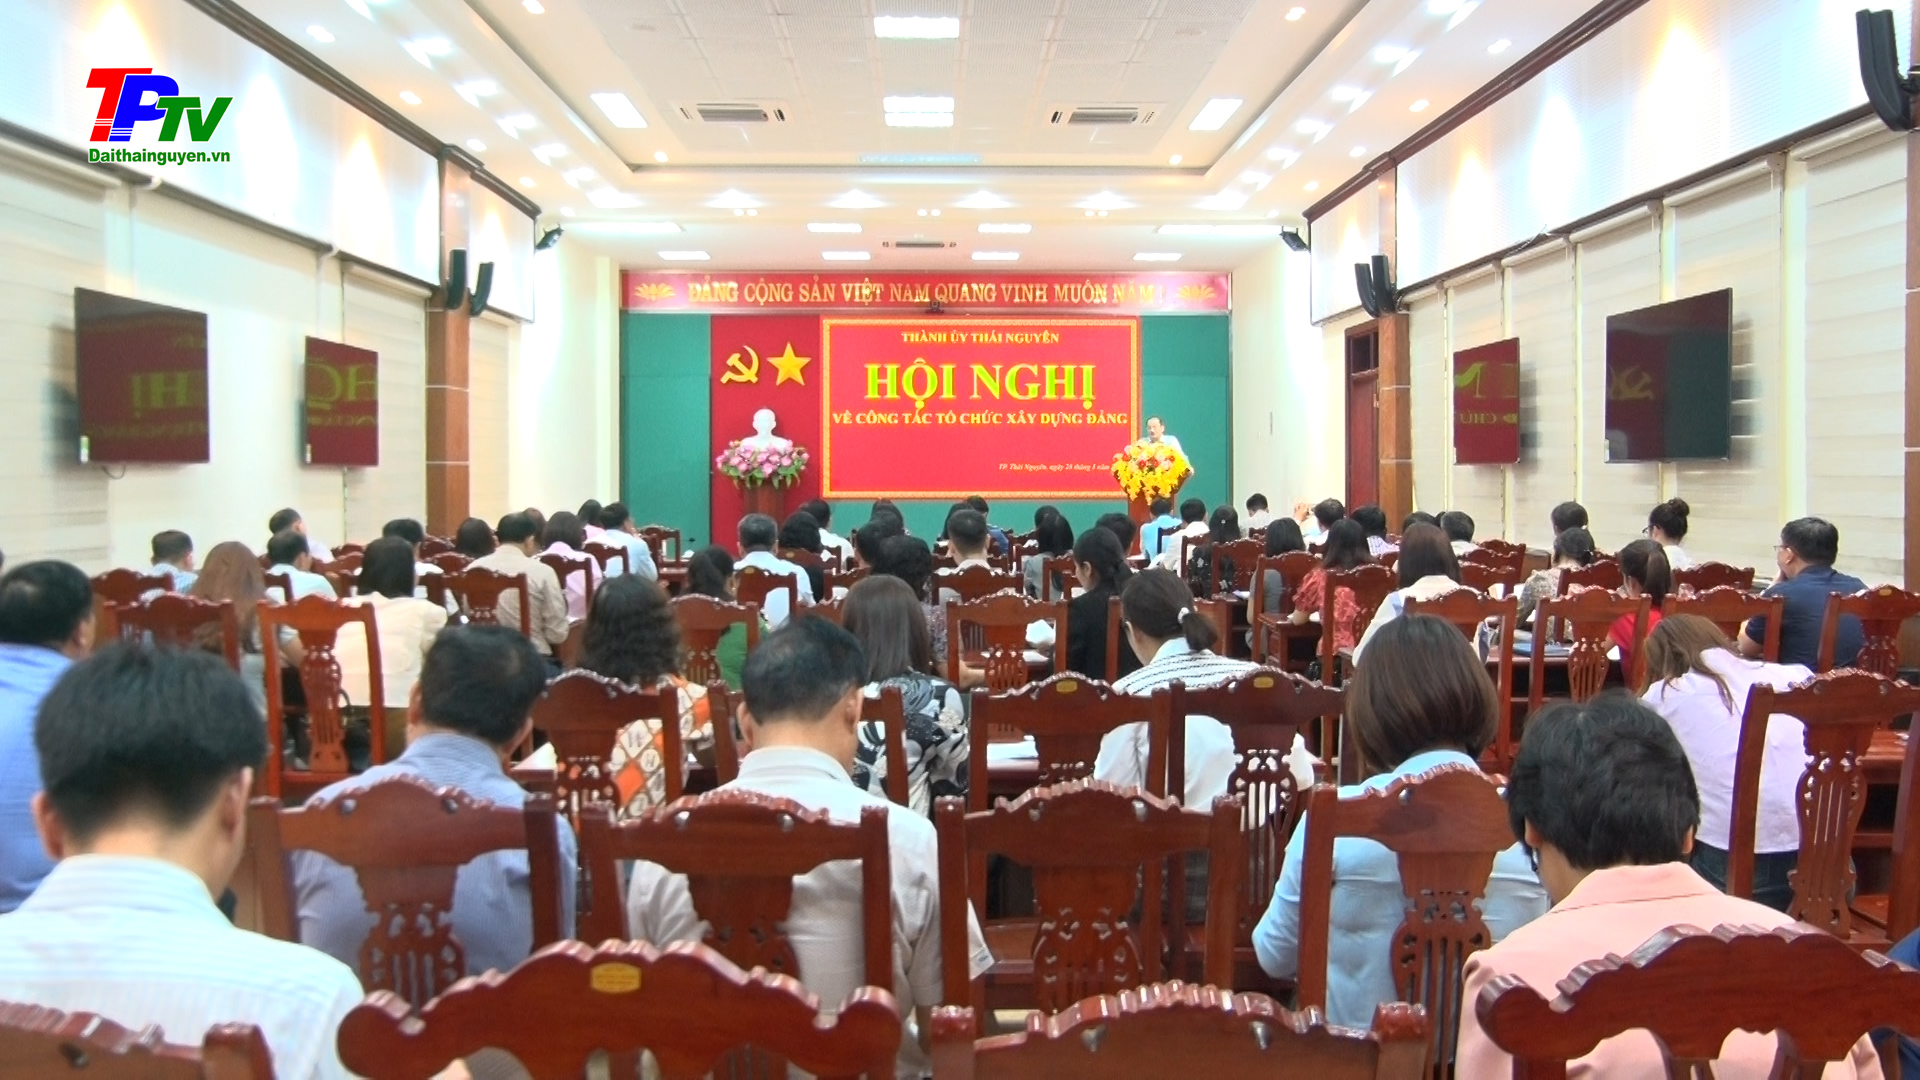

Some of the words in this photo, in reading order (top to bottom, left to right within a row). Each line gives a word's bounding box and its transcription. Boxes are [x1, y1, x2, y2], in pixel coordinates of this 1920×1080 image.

[687, 275, 739, 302] ĐẢNG
[744, 277, 794, 306] CỘNG
[799, 275, 836, 302] SẢN
[841, 277, 884, 306] VIỆT
[888, 283, 931, 302] NAM
[935, 283, 997, 304] QUANG
[1001, 283, 1048, 302] VINH
[1053, 279, 1108, 303] MUÔN
[901, 330, 947, 342] THÀNH
[970, 330, 1002, 342] THÁI
[1005, 330, 1060, 343] NGUYÊN
[863, 357, 957, 410] HỘI
[968, 363, 1097, 410] NGHỊ
[855, 409, 899, 424] CÔNG
[901, 409, 933, 424] TÁC
[959, 410, 1003, 424] CHỨC
[1006, 409, 1037, 424] XÂY
[1040, 411, 1083, 428] DỰNG
[1086, 409, 1129, 424] ĐẢNG
